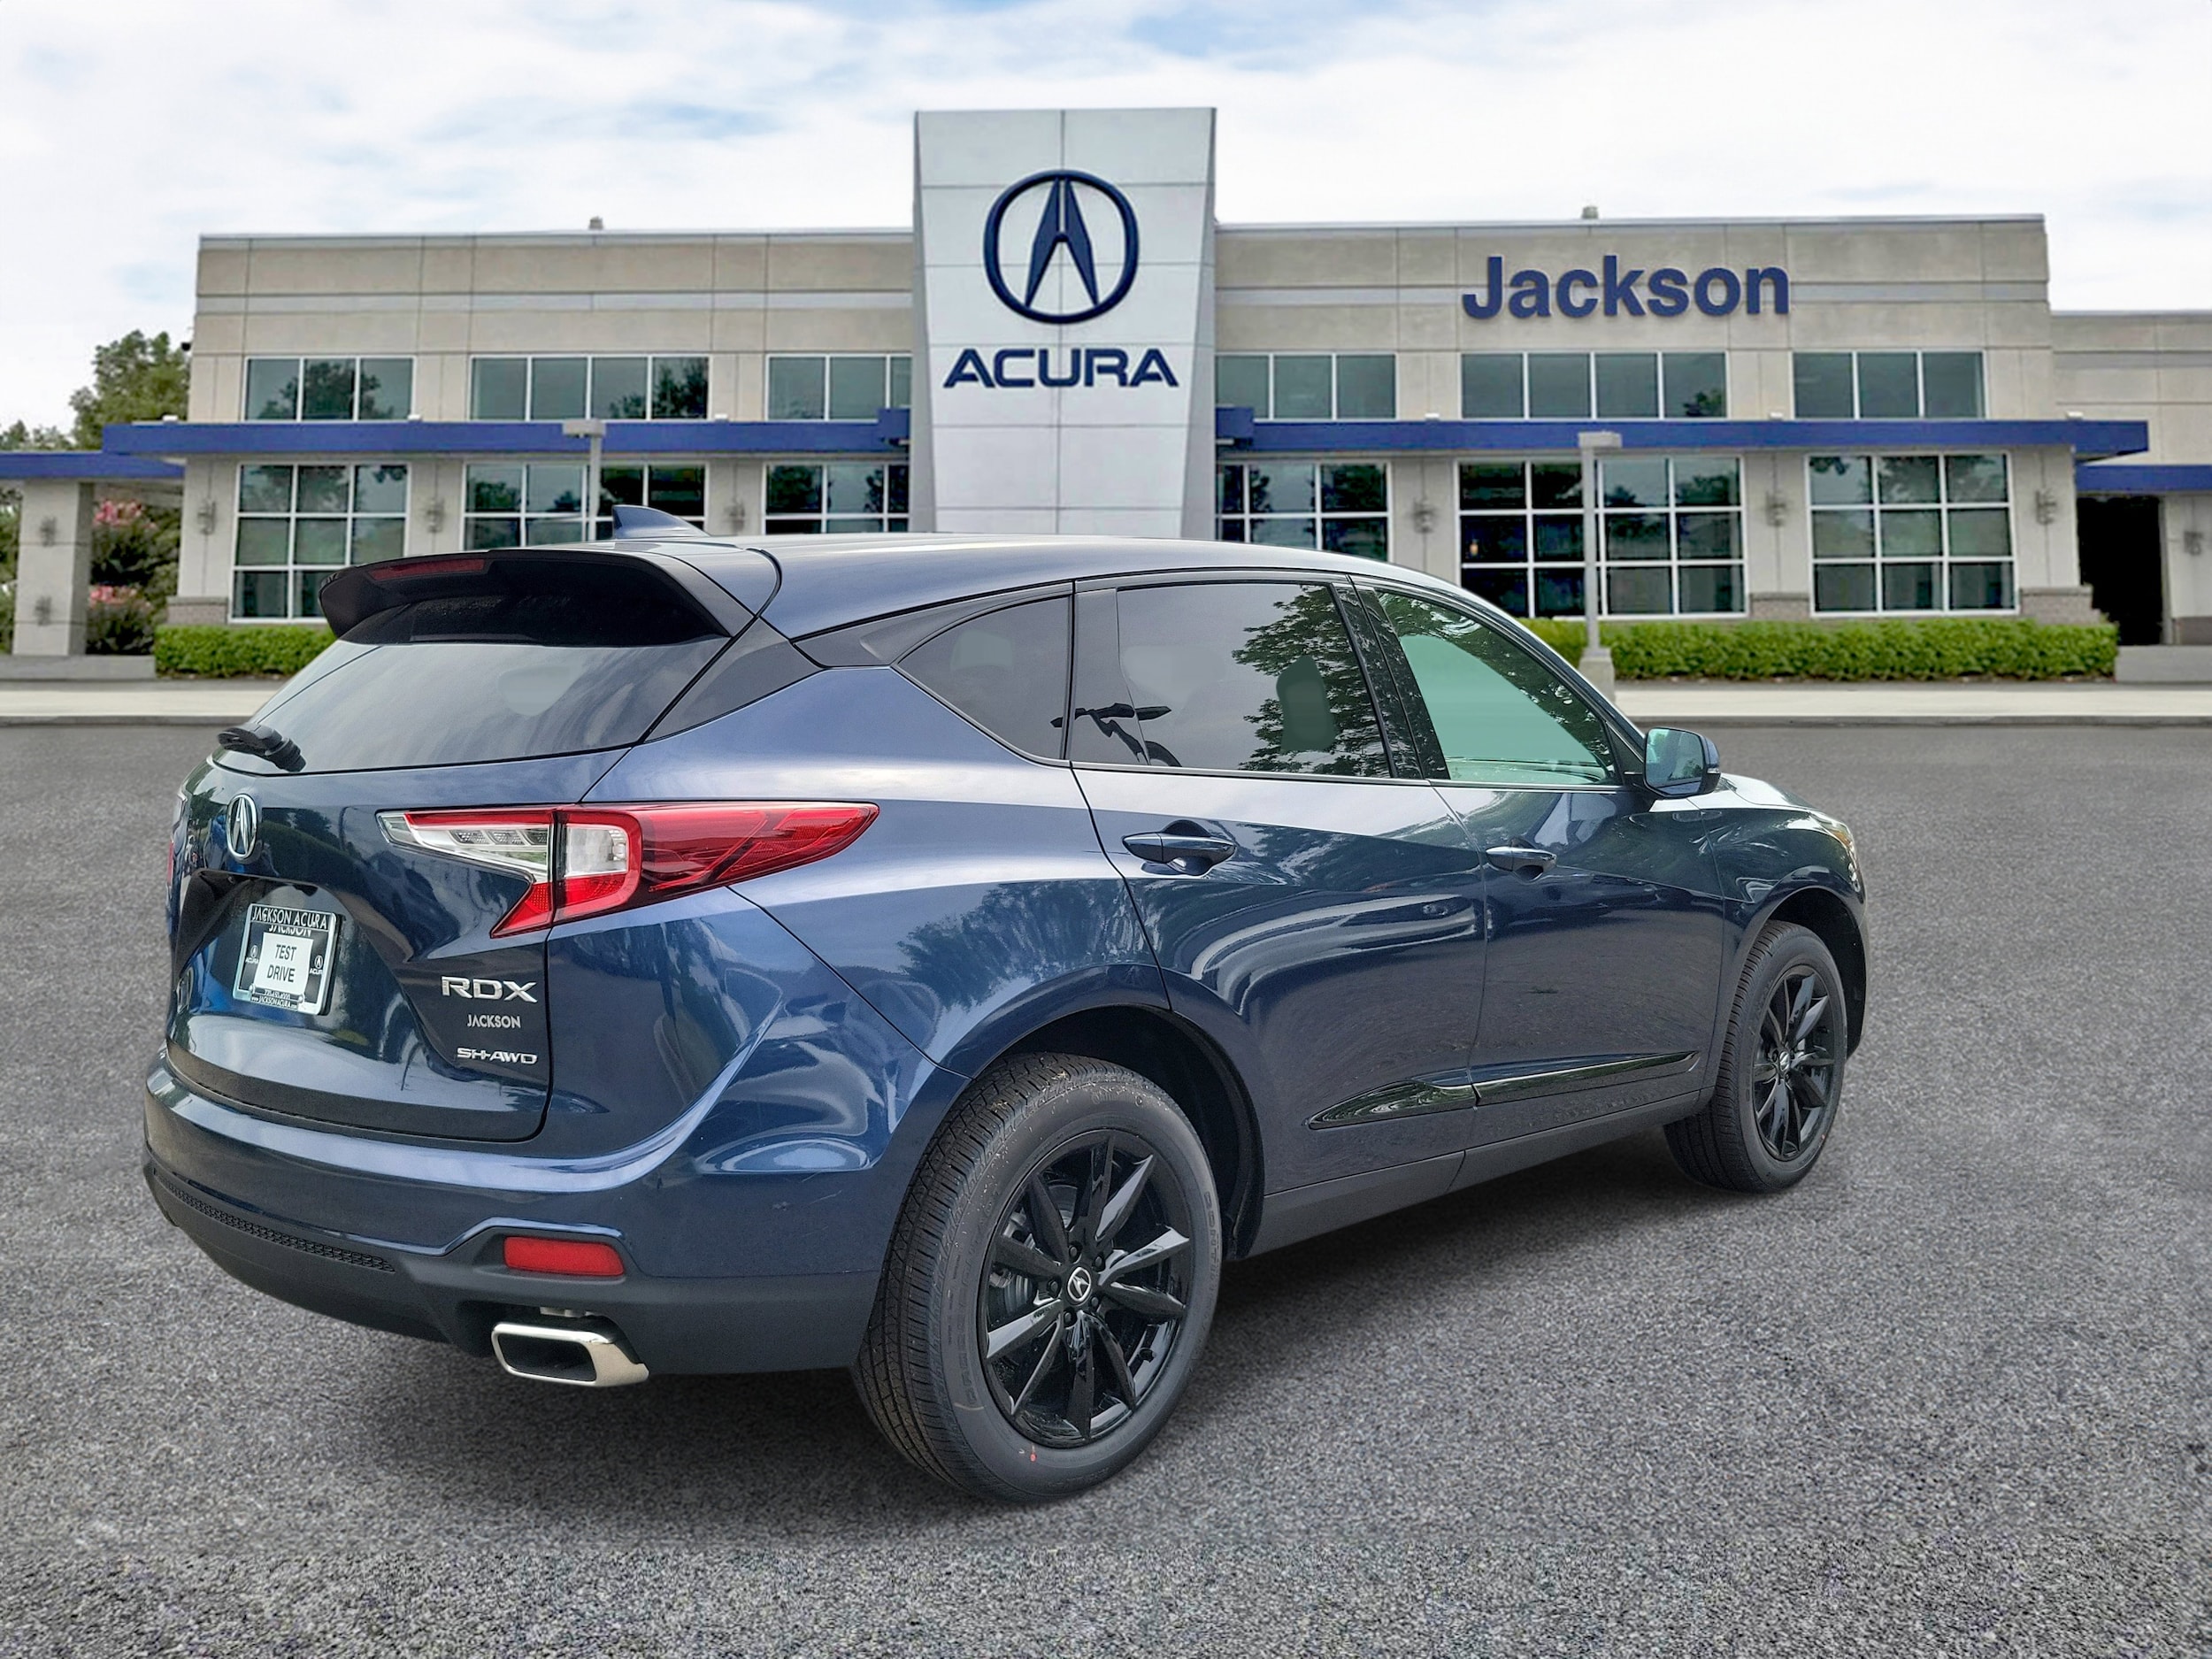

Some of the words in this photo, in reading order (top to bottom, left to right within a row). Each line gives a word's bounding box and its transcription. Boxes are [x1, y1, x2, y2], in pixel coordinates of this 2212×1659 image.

[1463, 256, 1788, 319] Jackson
[943, 347, 1179, 388] ACURA
[252, 906, 292, 925] JACKSON
[293, 911, 327, 929] ACURA
[275, 944, 297, 961] TEST
[266, 964, 296, 983] DRIVE
[442, 976, 538, 1003] RDX
[467, 1014, 521, 1028] JACKSON
[457, 1047, 538, 1064] SH-AWD
